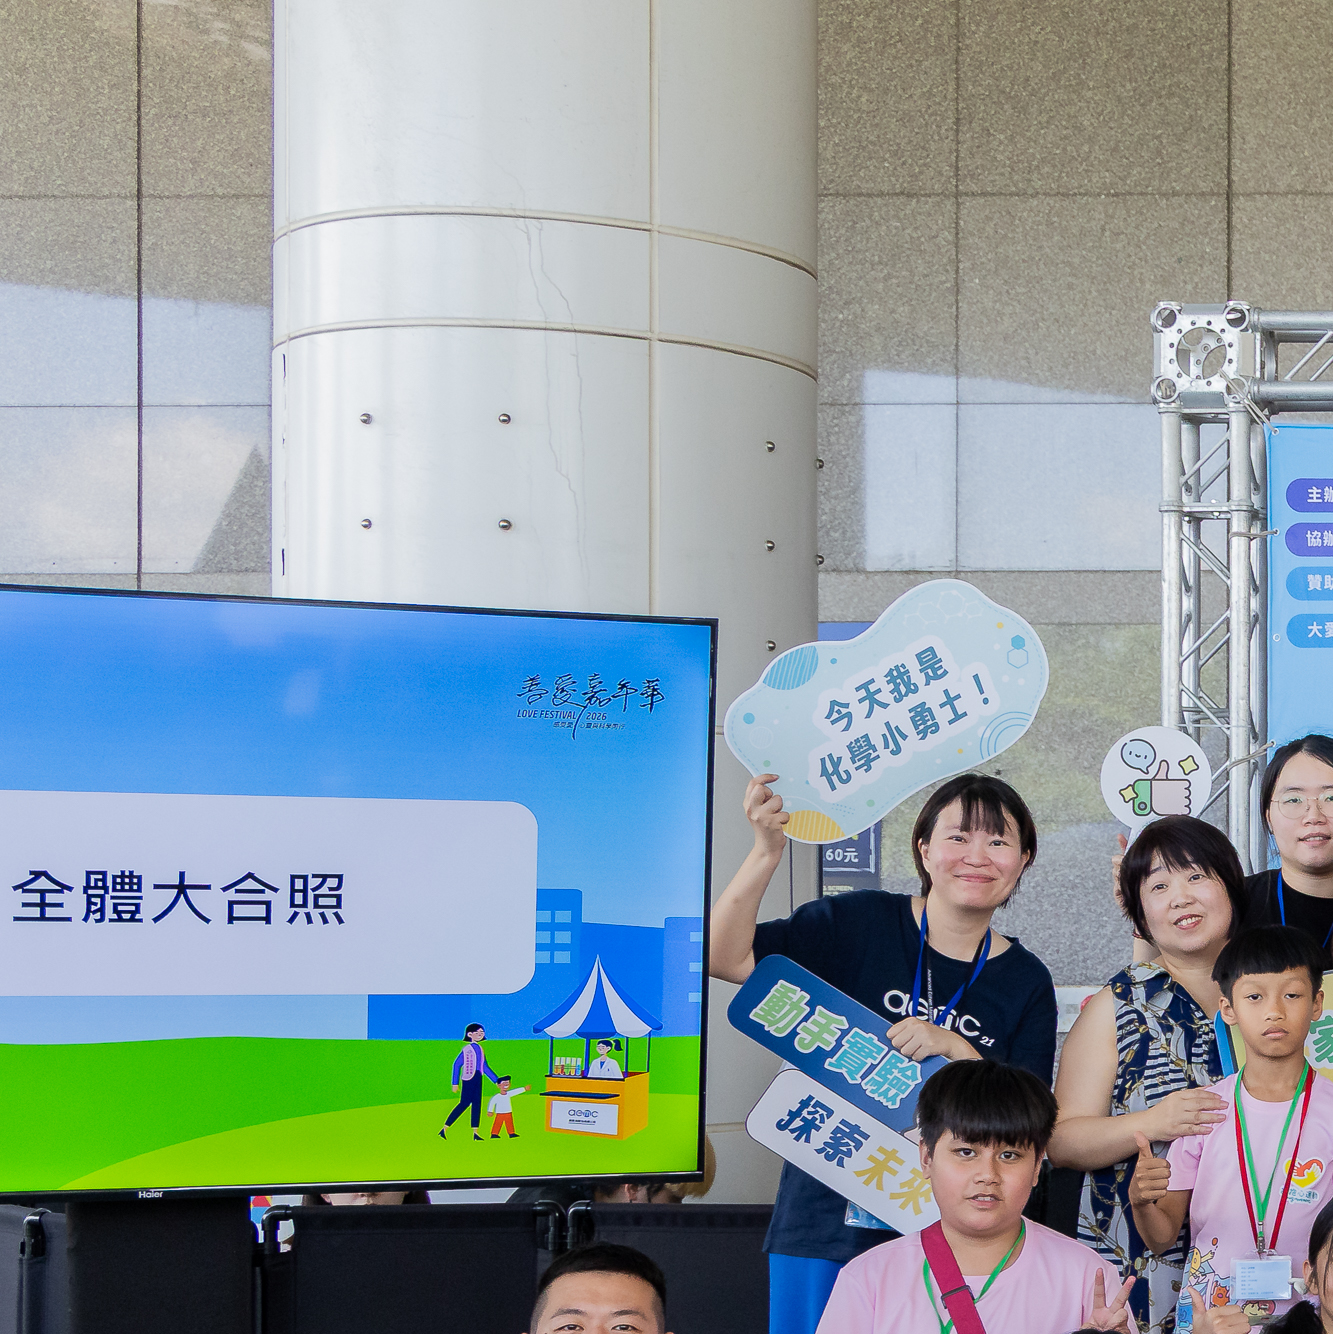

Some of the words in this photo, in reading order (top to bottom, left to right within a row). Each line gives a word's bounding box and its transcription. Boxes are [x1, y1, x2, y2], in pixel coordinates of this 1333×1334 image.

[824, 645, 949, 733] 今天我是
[516, 709, 539, 718] LOVE
[539, 710, 577, 720] FESTIVAL
[586, 712, 607, 720] 2026
[825, 847, 859, 862] 60元
[11, 869, 348, 927] 全體大合照
[750, 980, 921, 1108] 動手實驗
[980, 1036, 995, 1047] 21
[776, 1094, 932, 1215] 探索未來
[138, 1191, 163, 1199] Haier
